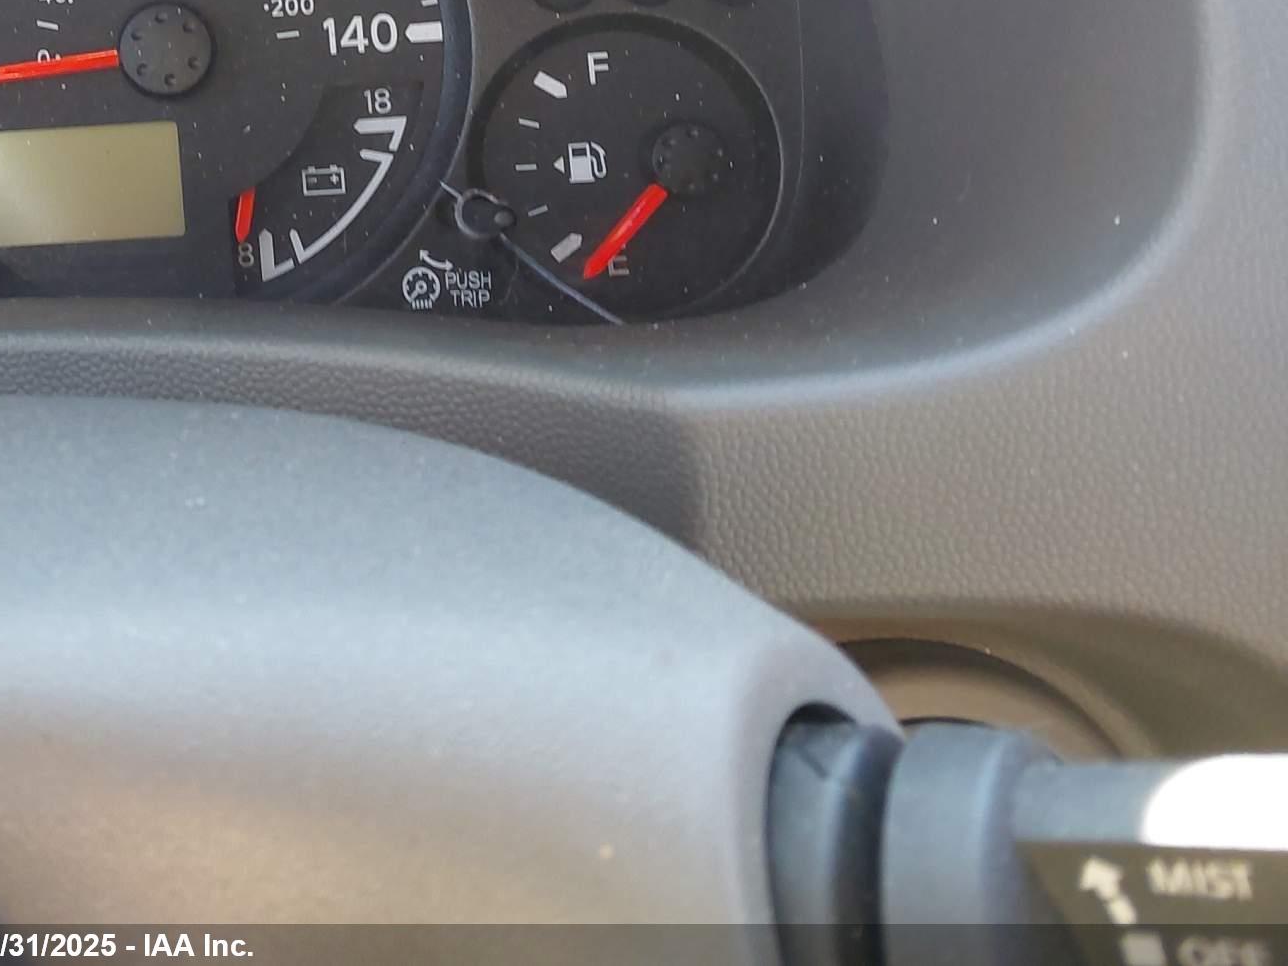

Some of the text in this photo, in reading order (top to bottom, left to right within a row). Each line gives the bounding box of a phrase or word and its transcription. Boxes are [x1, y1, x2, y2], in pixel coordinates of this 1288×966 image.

[322, 13, 398, 56] 140
[587, 51, 609, 85] F
[364, 88, 392, 114] 18
[238, 243, 255, 267] 8
[444, 269, 492, 290] PUSH
[450, 289, 490, 308] TRIP
[1145, 857, 1253, 900] MIST
